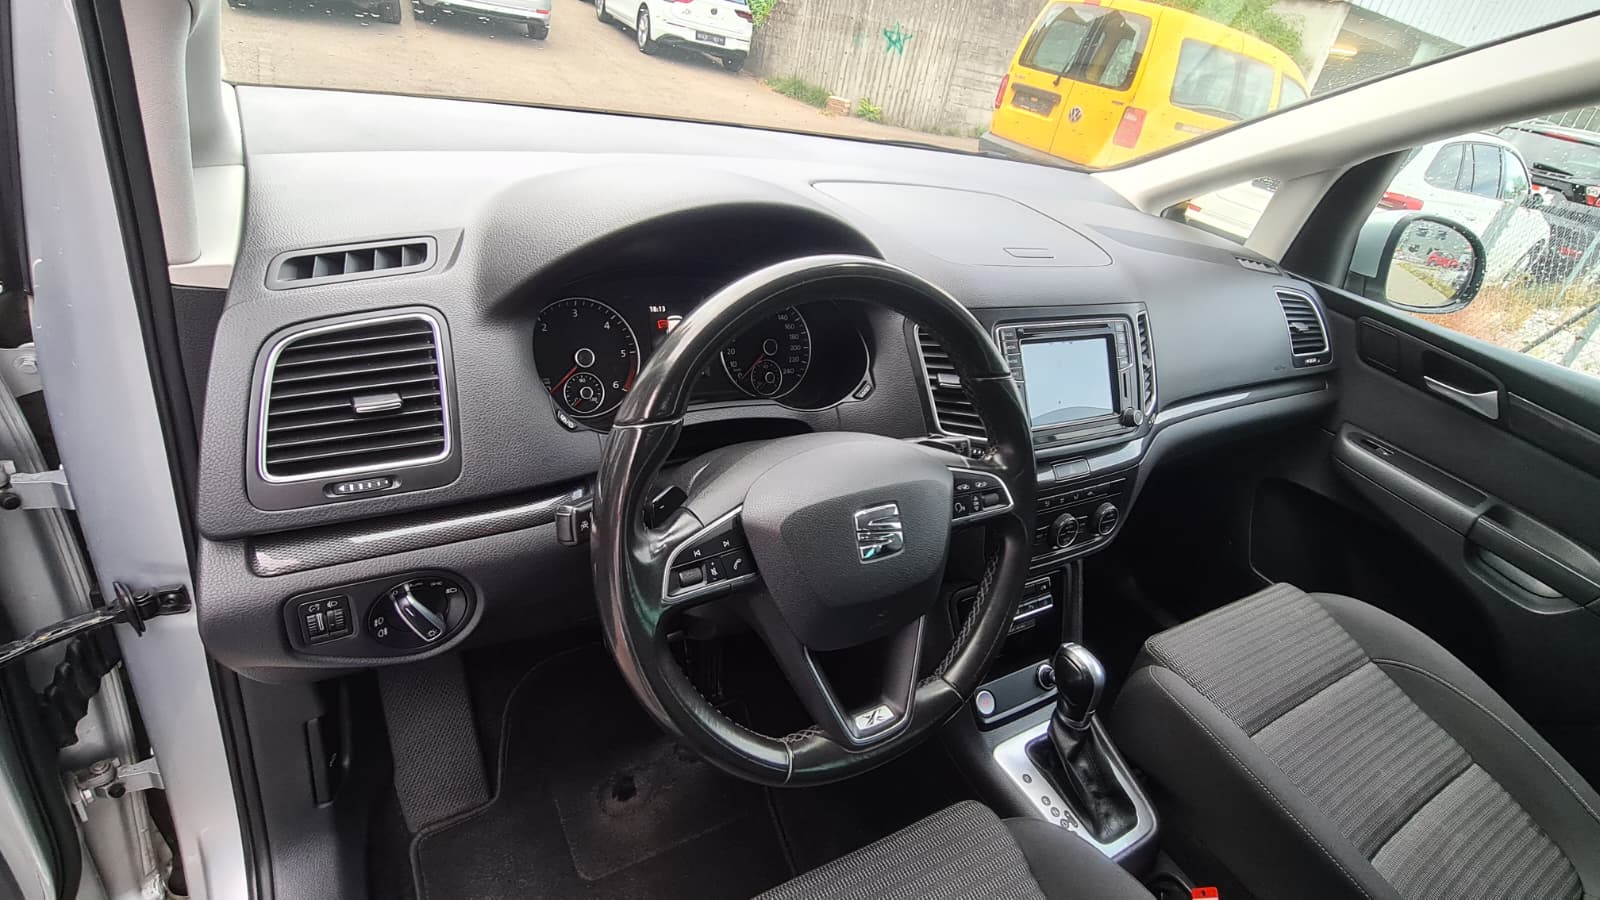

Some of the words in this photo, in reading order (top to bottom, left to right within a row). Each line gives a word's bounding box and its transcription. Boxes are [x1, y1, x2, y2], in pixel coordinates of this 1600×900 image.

[776, 313, 790, 321] 140
[541, 323, 548, 332] 2
[603, 321, 611, 330] 4
[620, 349, 627, 358] 5
[612, 380, 620, 389] 6
